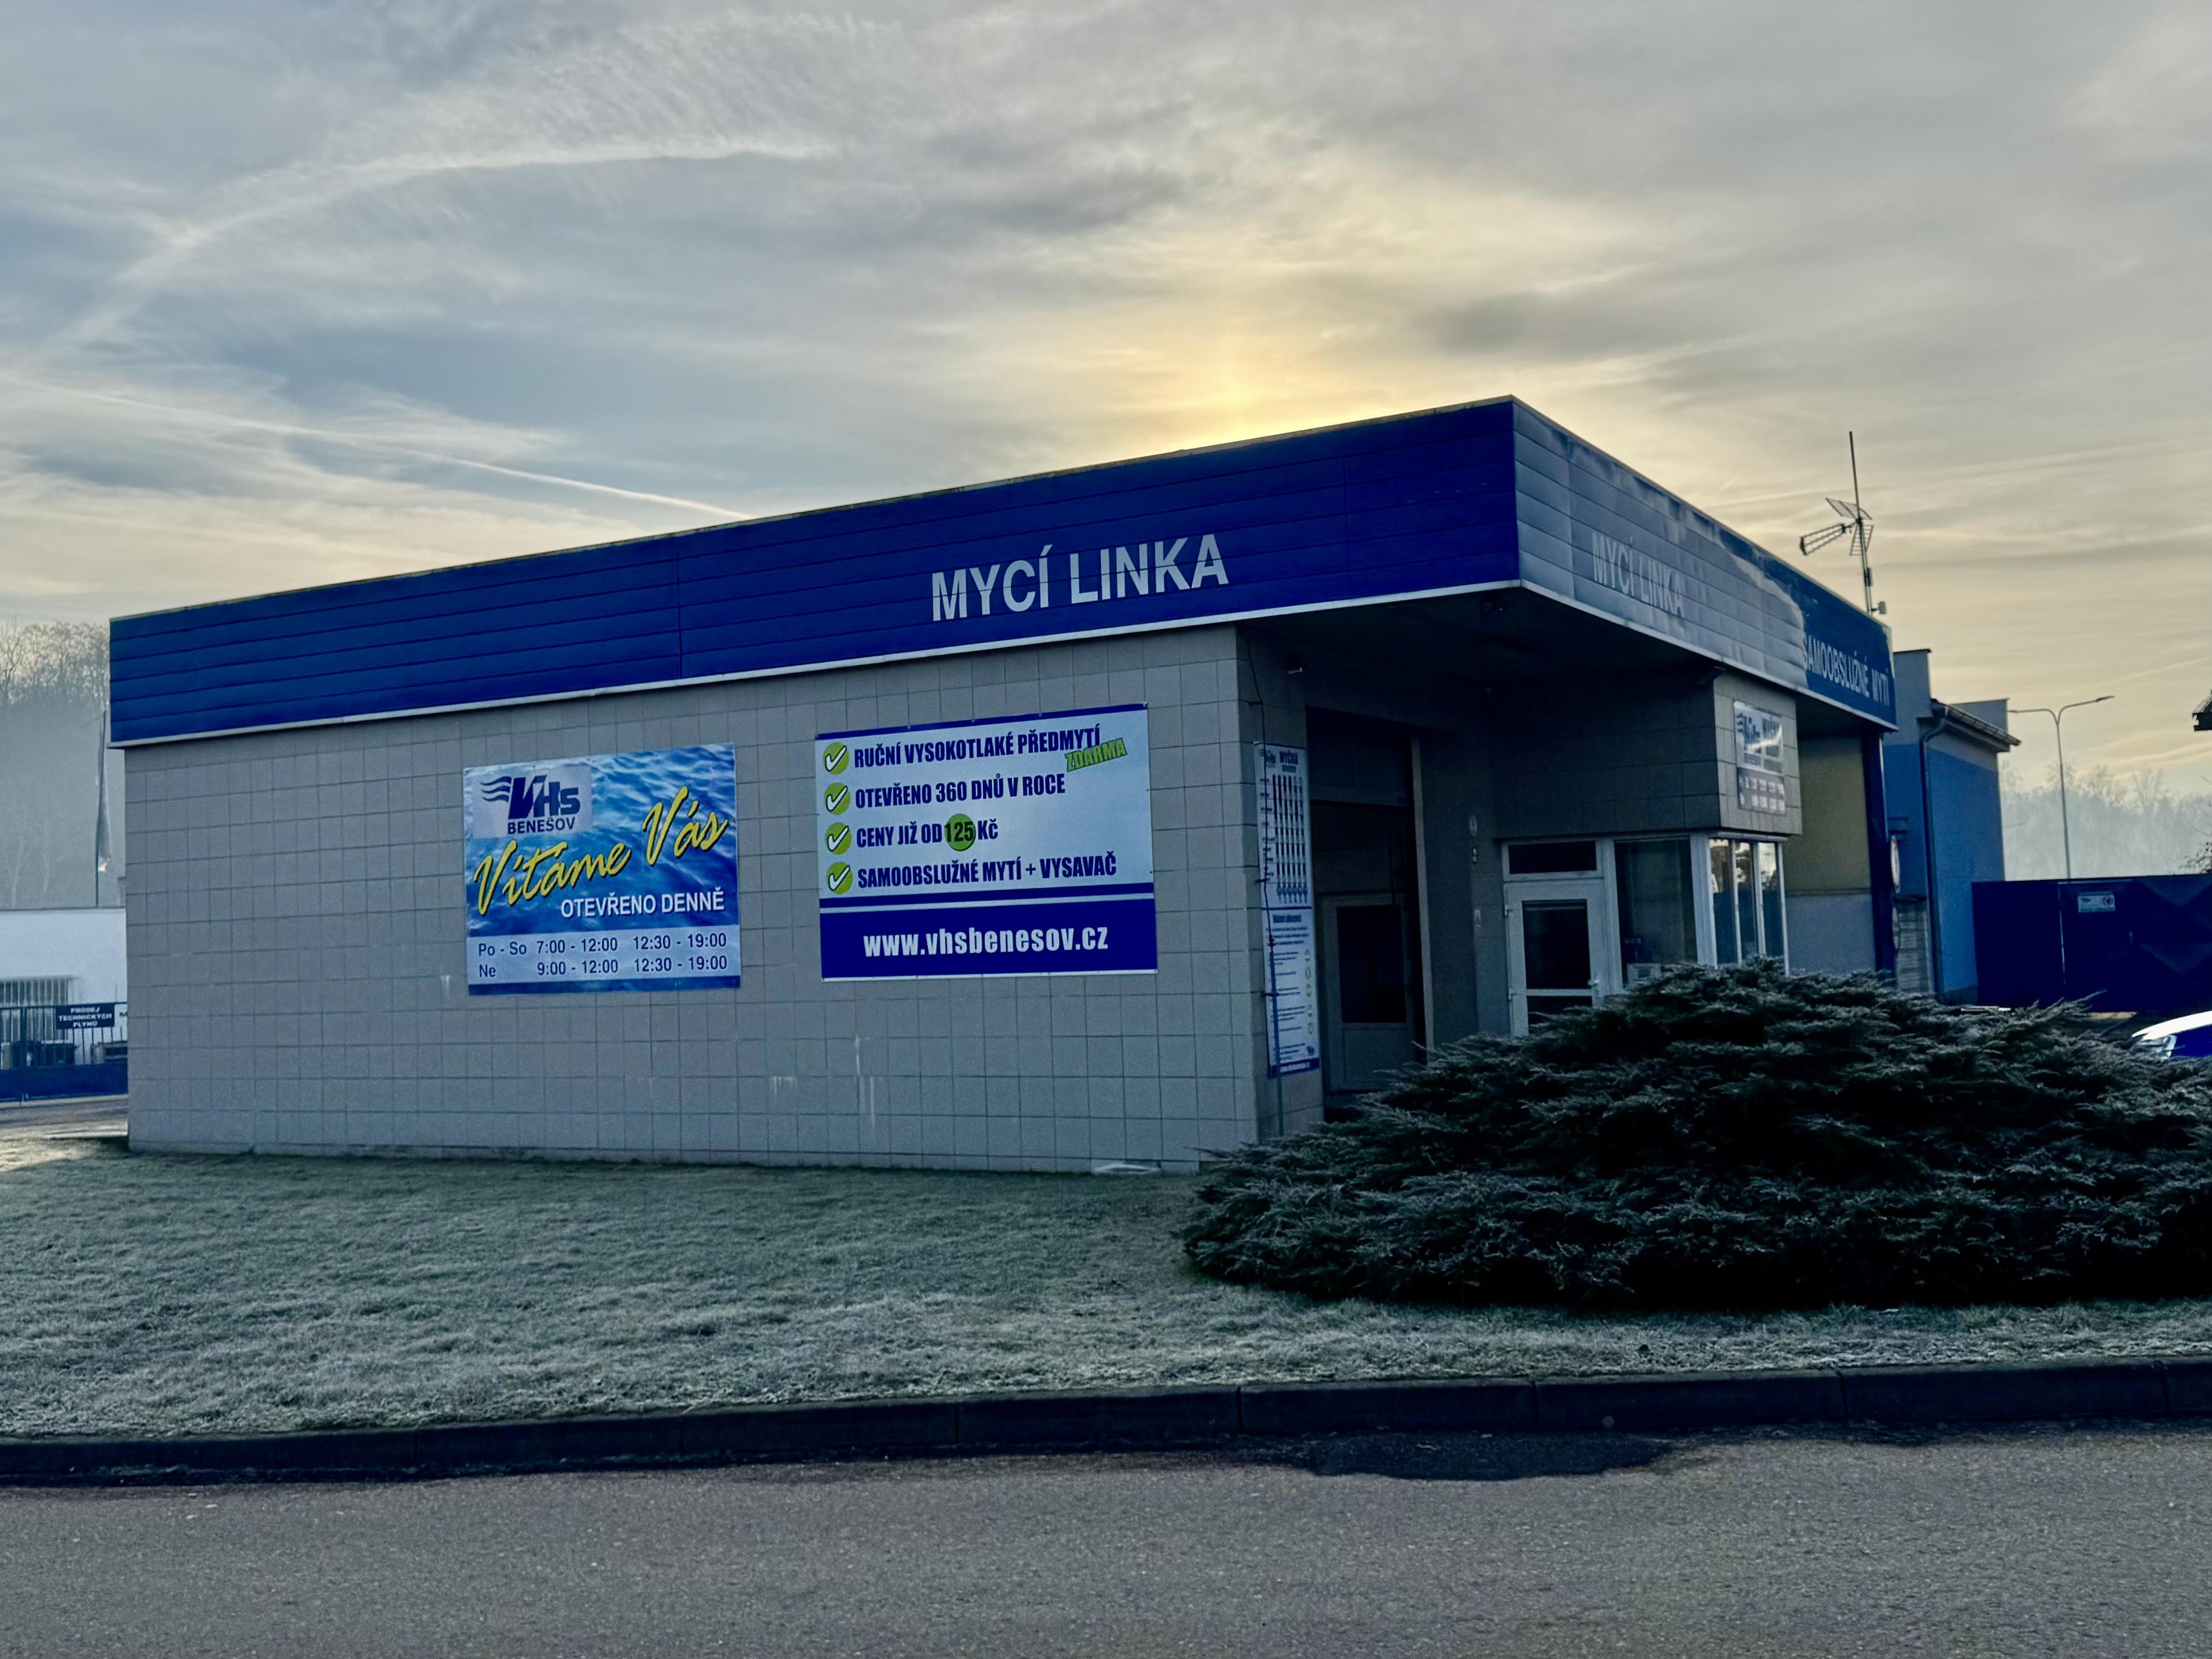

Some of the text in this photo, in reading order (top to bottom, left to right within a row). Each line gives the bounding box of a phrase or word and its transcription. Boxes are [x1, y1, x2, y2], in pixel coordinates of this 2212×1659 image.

[932, 534, 1229, 622] MYCÍ LINKA
[1592, 531, 1684, 618] MYCÍ LINKA
[854, 723, 1101, 768] RUČNÍ VYSOKOTLAKÉ PŘEDMYTÍ
[1064, 737, 1128, 773] ZDARMA
[855, 773, 1066, 808] OTEVŘENO 360 DNŮ V ROCE
[642, 786, 729, 867] Vás
[857, 818, 998, 848] CENY JIŽ OD 125 KČ
[857, 851, 1116, 888] SAMOOBSLUŽNÉ MYTÍ + VYSAVAČ
[560, 886, 724, 918] OTEVŘENO DENNĚ
[478, 943, 495, 957] Po
[509, 941, 527, 956] So
[537, 940, 565, 954] 7:00
[581, 937, 618, 952] 12:00
[633, 935, 671, 950] 12:30
[688, 933, 727, 948] 19:00
[863, 927, 1108, 957] www.vhsbenesov.cz
[479, 964, 496, 978] Ne
[537, 961, 566, 975] 9:00
[581, 959, 618, 973] 12:00
[634, 957, 672, 972] 12:30
[688, 955, 727, 971] 19:00
